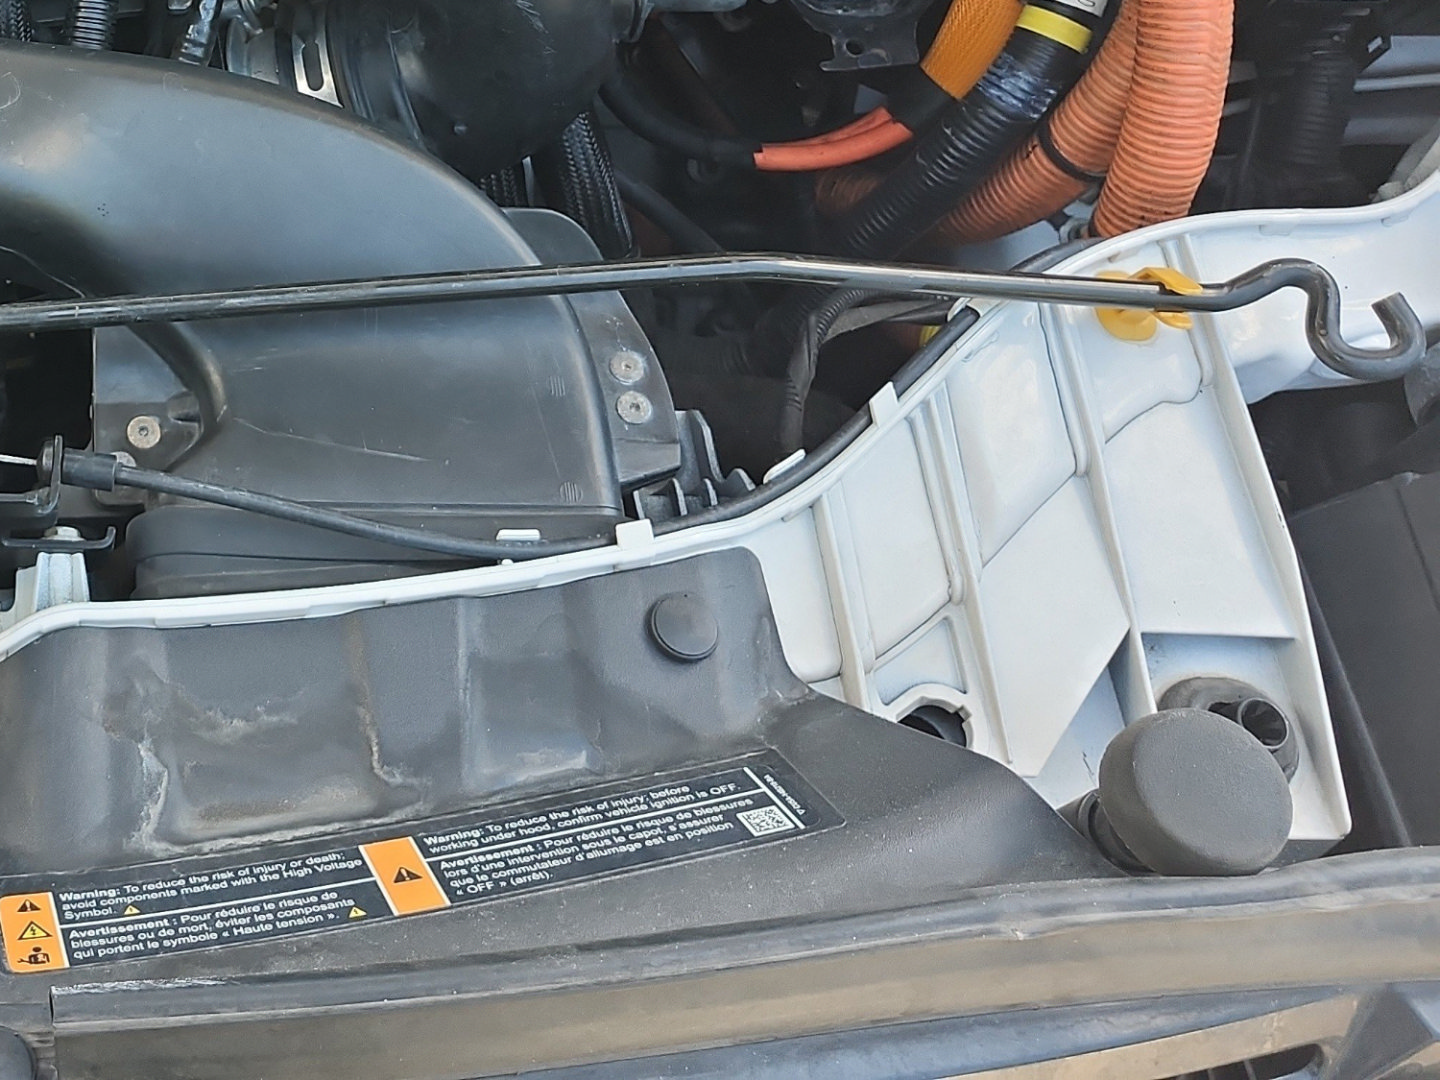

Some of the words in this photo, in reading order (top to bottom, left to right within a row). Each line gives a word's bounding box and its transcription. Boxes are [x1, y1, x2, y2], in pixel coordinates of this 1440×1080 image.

[423, 828, 484, 845] Warning:
[485, 824, 502, 833] To
[505, 816, 547, 830] reduce
[549, 811, 570, 820] the
[572, 805, 595, 816] risk
[597, 801, 609, 810] of
[610, 795, 649, 807] injury;
[649, 786, 690, 799] before
[429, 836, 479, 853] working
[478, 831, 516, 843] under
[518, 823, 555, 836] hood,
[557, 814, 603, 827] confirm
[604, 801, 648, 817] vehicle
[649, 794, 695, 809] ignition
[710, 783, 741, 795] OFF.
[441, 844, 535, 870] Avertissement
[543, 837, 573, 849] Pour
[576, 828, 620, 842] réduire
[636, 816, 674, 829] risque
[676, 812, 692, 820] de
[692, 799, 753, 816] blessures
[444, 869, 468, 878] lors
[470, 861, 505, 873] d'une
[507, 846, 580, 866] intervention
[582, 839, 612, 850] sous
[628, 827, 667, 840] capot,
[668, 814, 723, 831] s'assurer
[450, 877, 474, 888] que
[476, 874, 489, 882] le
[492, 857, 572, 879] commutateur
[575, 842, 642, 861] d'allumage
[645, 836, 666, 846] est
[667, 833, 684, 841] en
[685, 822, 734, 840] position
[59, 888, 120, 901] Warning:
[123, 885, 139, 893] To
[142, 879, 186, 891] reduce
[188, 876, 209, 884] the
[212, 871, 235, 881] risk
[238, 867, 250, 876] of
[252, 863, 286, 874] injury
[290, 860, 302, 868] or
[305, 853, 345, 865] death;
[62, 899, 97, 910] avoid
[100, 889, 178, 906] components
[180, 880, 228, 895] marked
[230, 876, 257, 887] with
[259, 872, 280, 882] the
[281, 867, 312, 878] High
[314, 859, 362, 872] Voltage
[466, 881, 494, 893] OFF
[510, 871, 553, 886] (arrêt).
[64, 903, 117, 920] Symbol.
[69, 918, 170, 938] Avertissement
[180, 913, 212, 924] Pour
[215, 905, 260, 918] réduire
[263, 902, 276, 910] le
[279, 896, 318, 908] risque
[321, 892, 338, 900] de
[71, 934, 135, 948] blessures
[138, 932, 155, 940] ou
[158, 928, 175, 937] de
[178, 922, 212, 934] mort,
[215, 916, 251, 928] éviter
[254, 913, 274, 922] les
[277, 899, 355, 918] composants
[74, 948, 94, 960] qui
[98, 942, 145, 957] portent
[147, 941, 159, 949] le
[163, 930, 218, 947] symbole
[233, 923, 273, 936] Haute
[275, 914, 324, 928] tension
